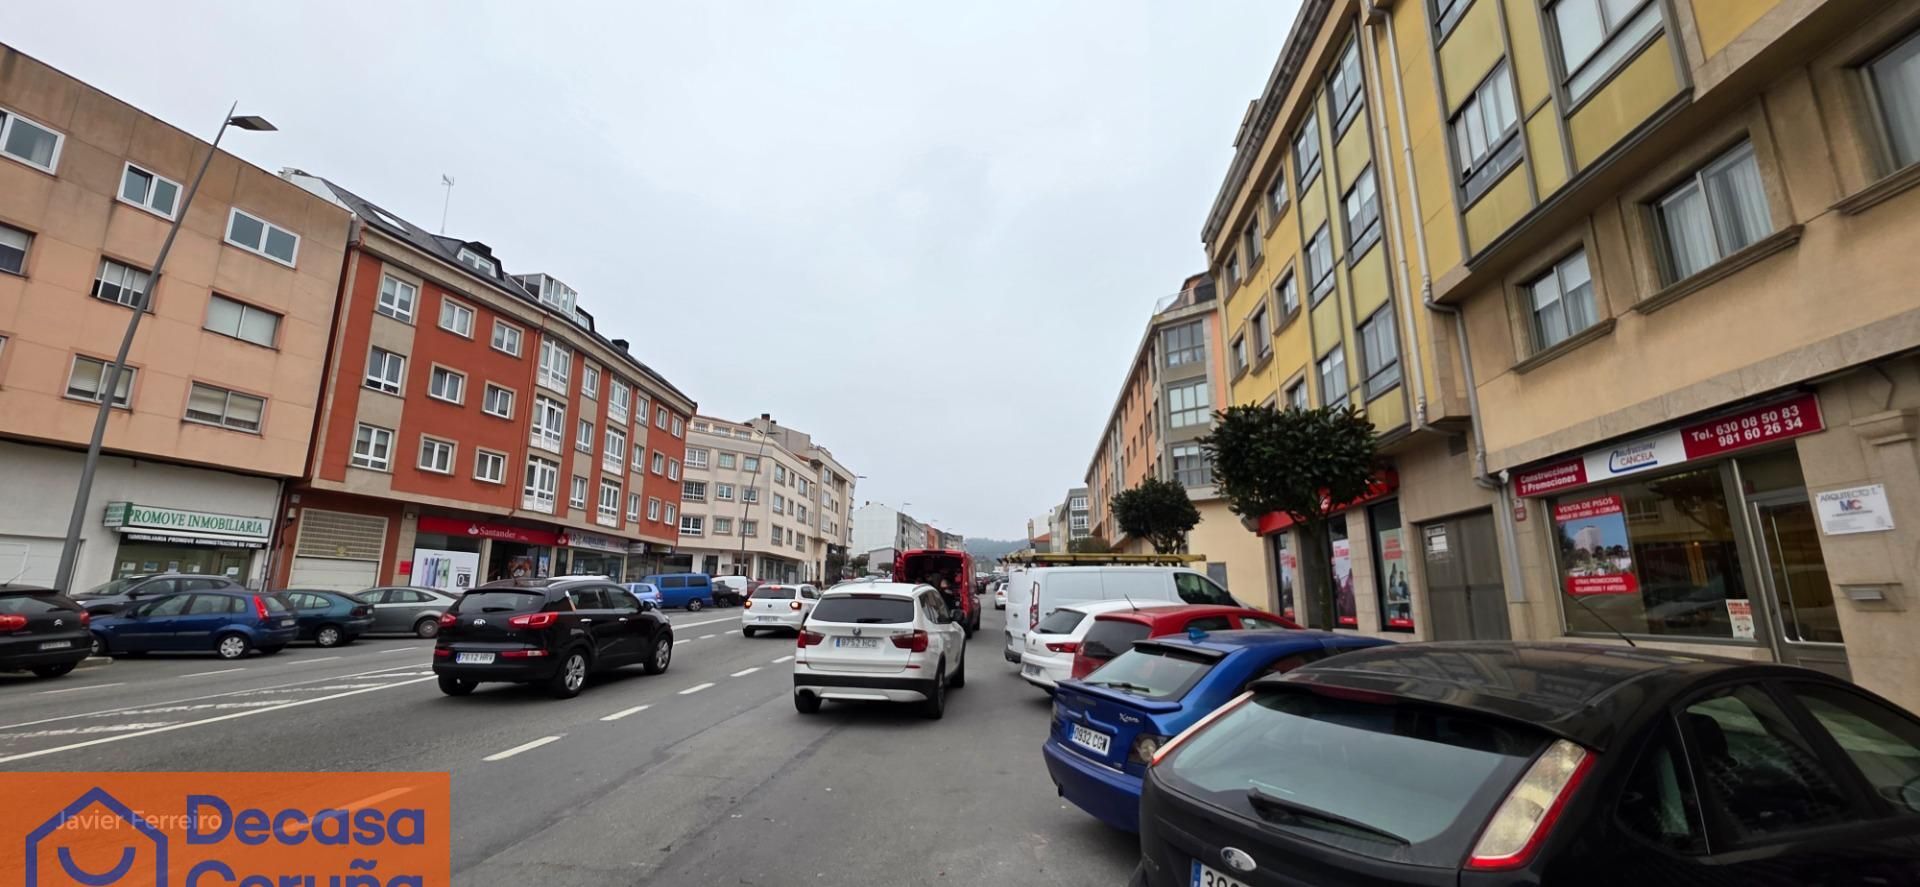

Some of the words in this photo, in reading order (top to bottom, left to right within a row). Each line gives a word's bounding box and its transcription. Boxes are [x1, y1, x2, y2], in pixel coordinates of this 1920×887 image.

[1691, 429, 1714, 442] Tel.
[1716, 421, 1739, 436] 630
[1741, 416, 1758, 429] 08
[1761, 411, 1778, 424] 50
[1782, 405, 1800, 419] 83
[1718, 433, 1740, 447] 981
[1744, 428, 1761, 440] 60
[1764, 422, 1782, 436] 26
[1785, 417, 1803, 431] 34
[1620, 451, 1655, 466] CANCELA
[1520, 463, 1579, 484] Construcciones
[1528, 474, 1577, 493] Promociones
[1559, 503, 1581, 513] VENTA
[1581, 501, 1591, 509] DE
[1592, 497, 1614, 508] PISOS
[128, 509, 185, 527] PROMOVE
[188, 514, 263, 534] INMOBILIARIA
[479, 526, 517, 539] Santander
[1074, 724, 1092, 745] 0932
[1092, 733, 1109, 753] CGW
